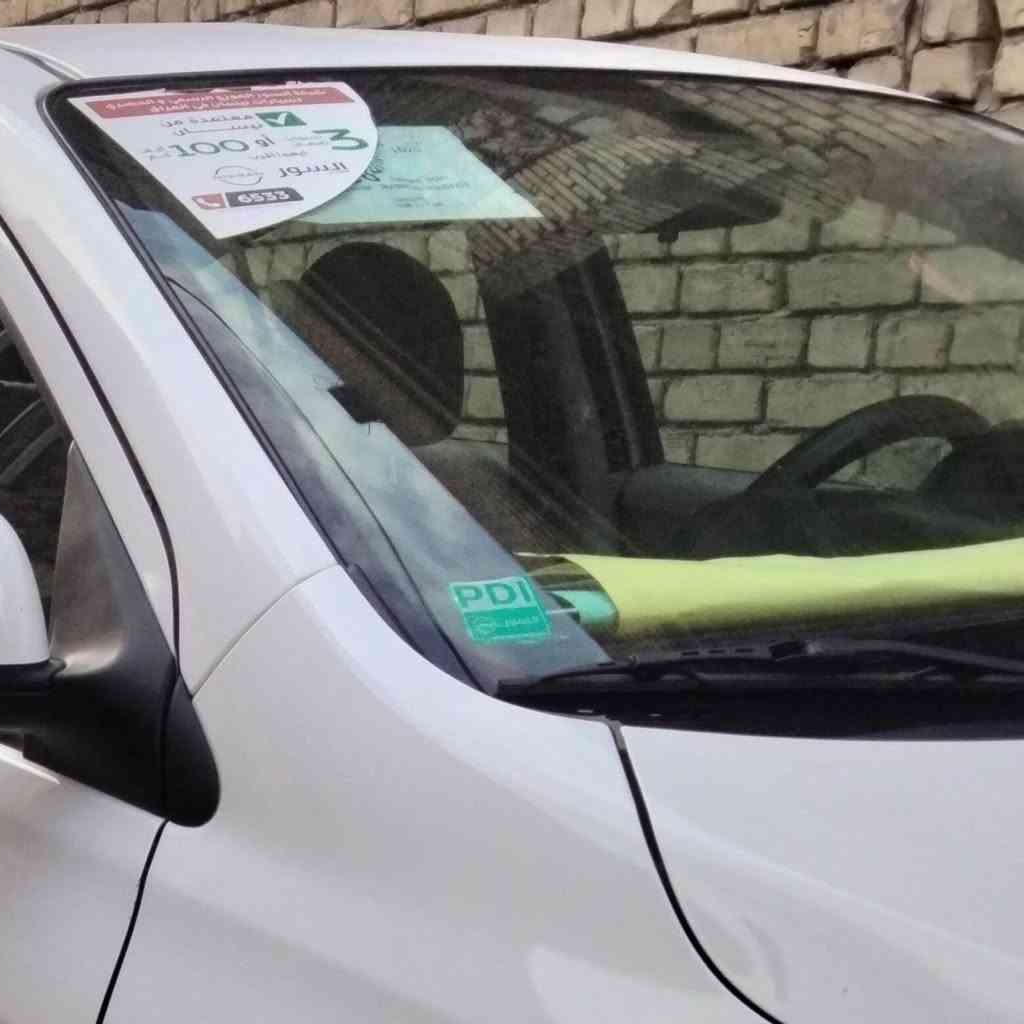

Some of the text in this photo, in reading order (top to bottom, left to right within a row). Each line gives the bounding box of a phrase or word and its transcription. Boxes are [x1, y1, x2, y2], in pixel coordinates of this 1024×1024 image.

[167, 139, 250, 158] 100
[312, 128, 368, 151] 3
[237, 190, 290, 204] 6533
[455, 583, 531, 608] PDI
